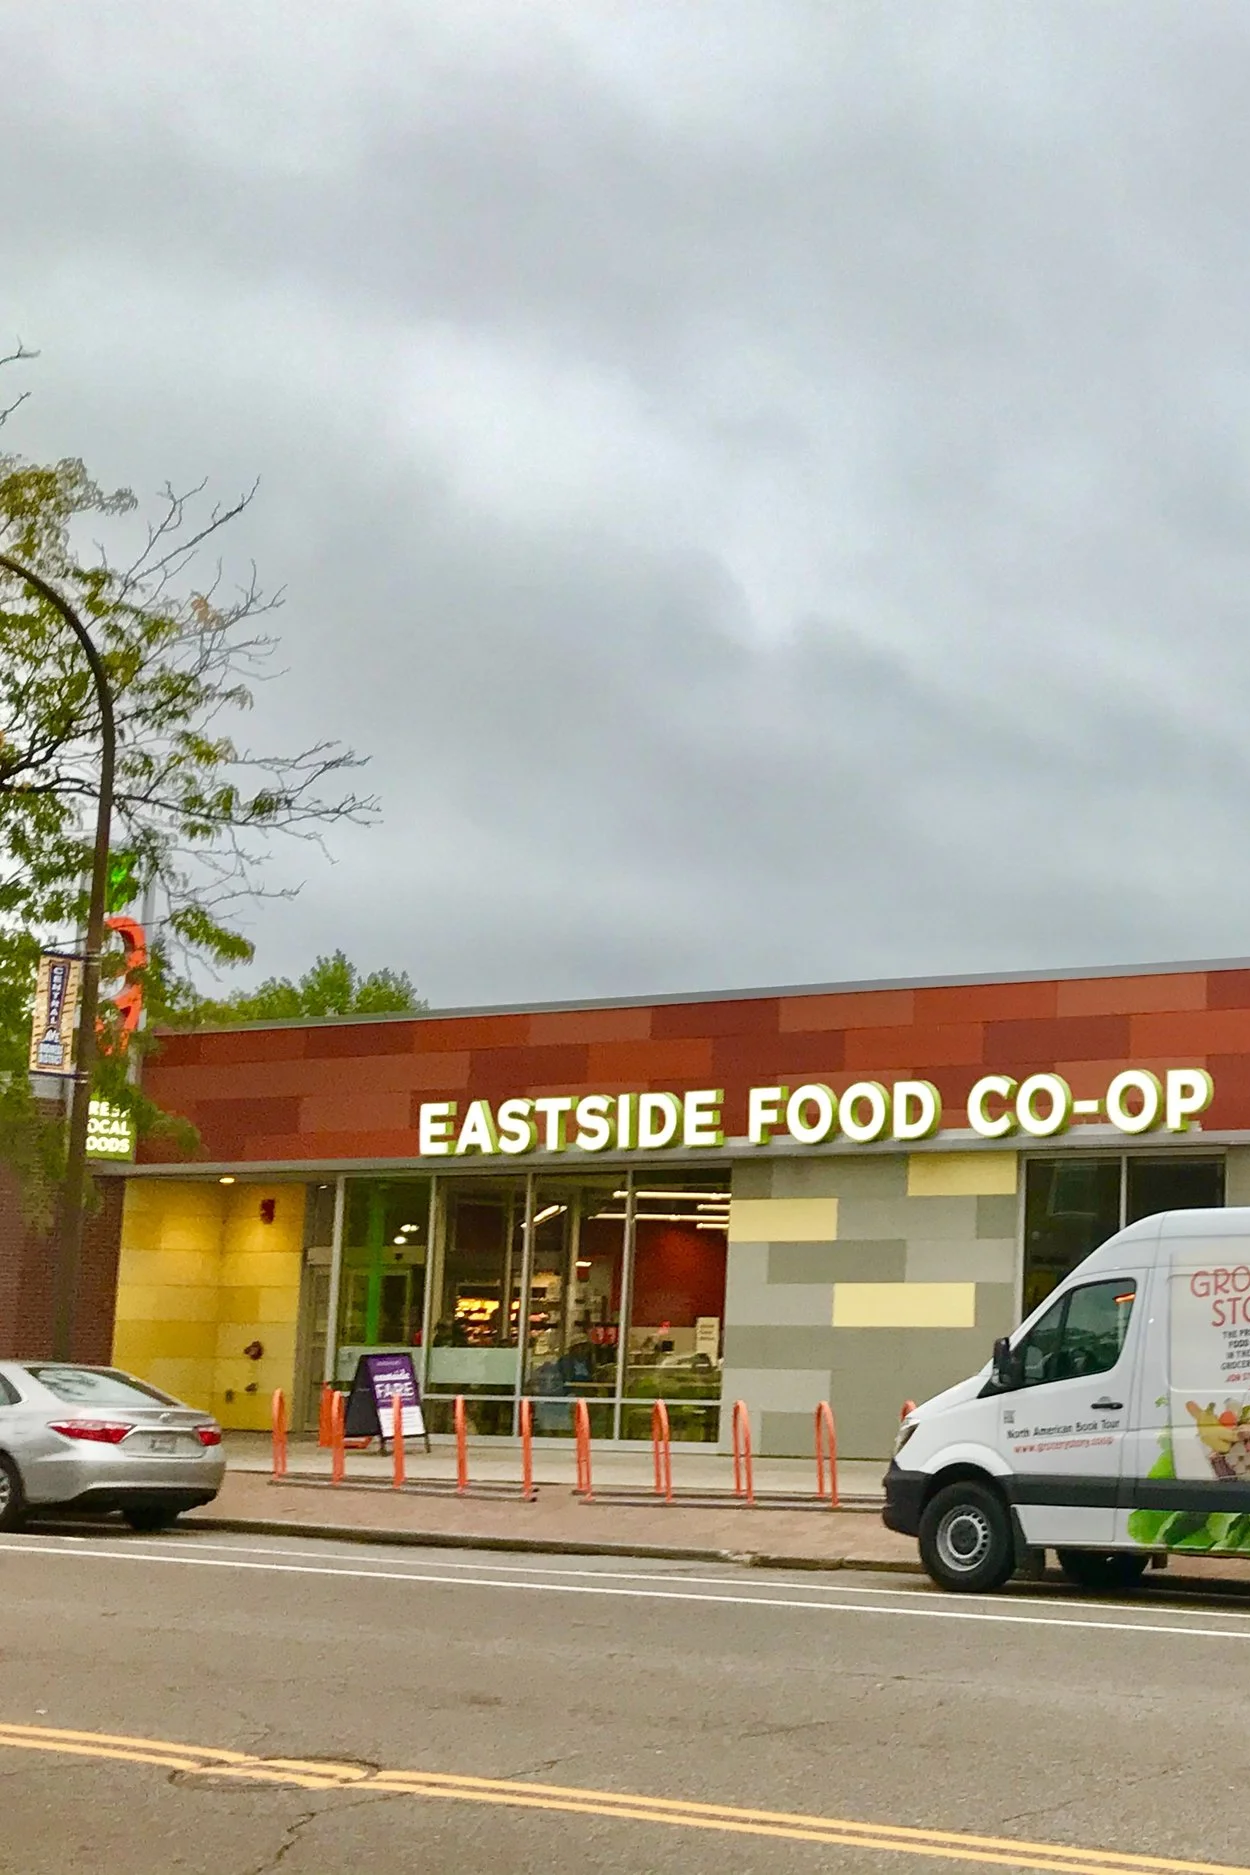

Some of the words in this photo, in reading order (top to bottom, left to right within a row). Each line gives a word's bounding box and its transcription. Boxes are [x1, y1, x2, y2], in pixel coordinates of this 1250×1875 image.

[49, 967, 64, 1024] CENTRAL
[419, 1089, 724, 1155] EASTSIDE
[748, 1080, 941, 1144] FOOD
[966, 1068, 1214, 1138] CO-OP
[87, 1118, 131, 1136] OCAL
[85, 1135, 130, 1153] OODS
[1007, 1427, 1030, 1439] North
[1033, 1424, 1073, 1436] American
